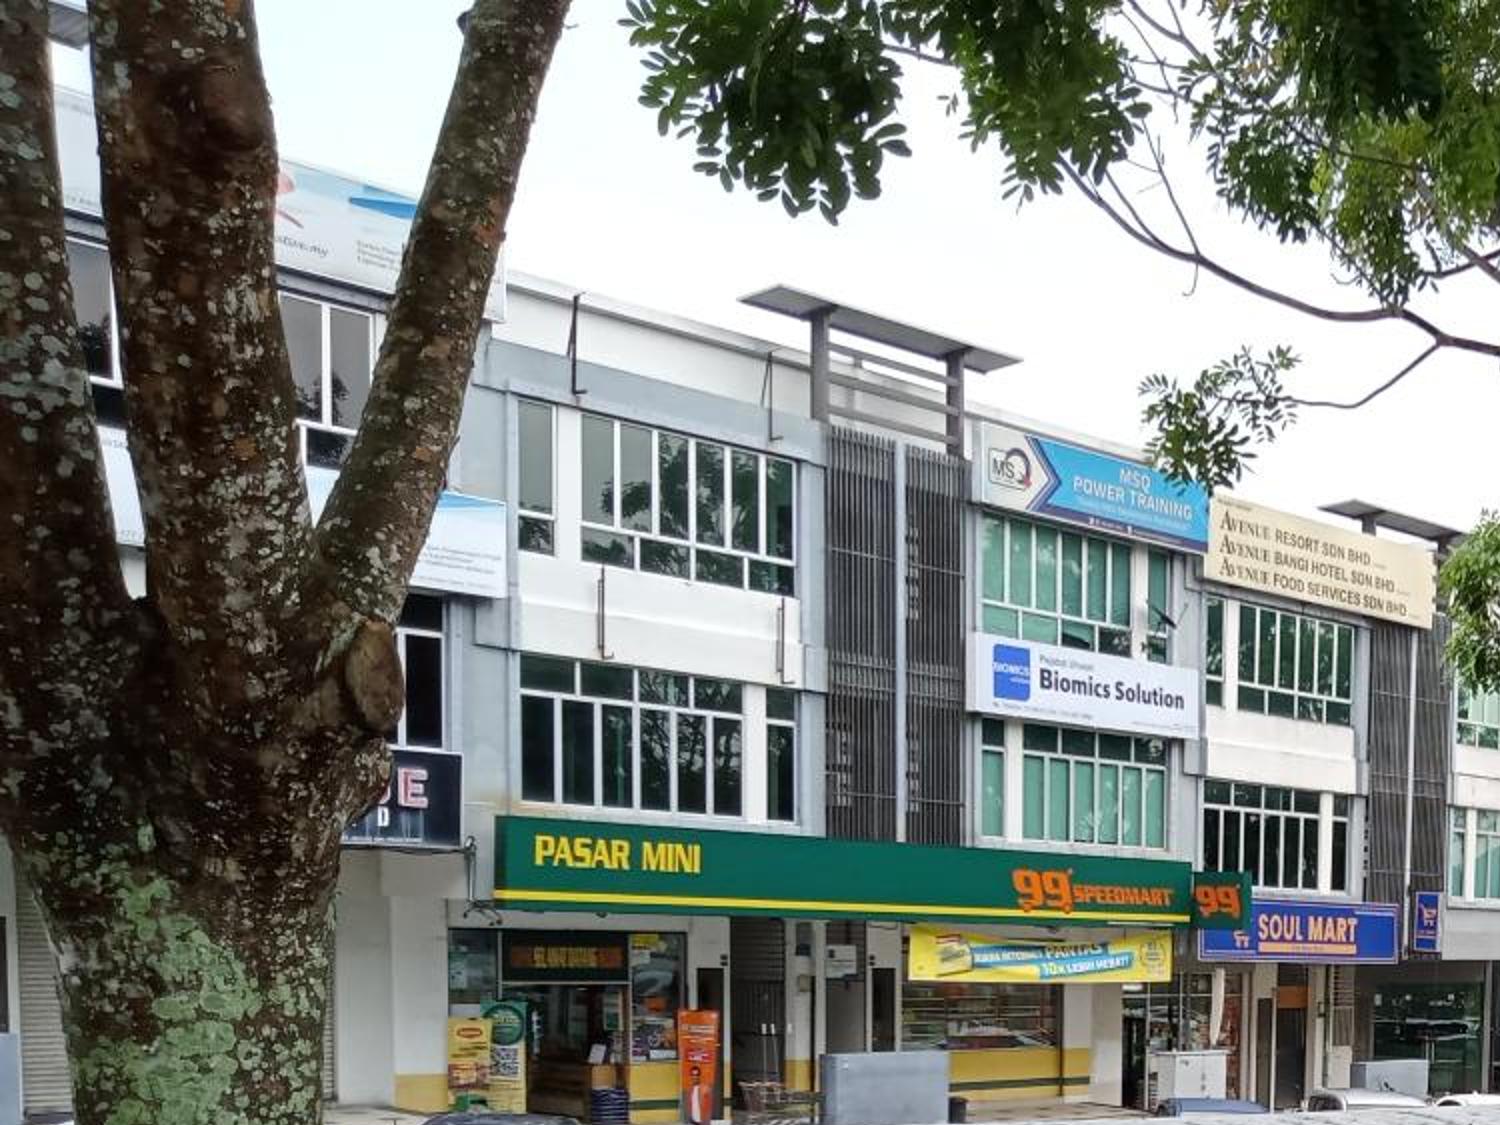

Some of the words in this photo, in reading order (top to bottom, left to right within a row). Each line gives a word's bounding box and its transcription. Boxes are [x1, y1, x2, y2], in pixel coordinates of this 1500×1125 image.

[1073, 476, 1125, 504] POWER
[1130, 490, 1193, 520] TRAINING
[1120, 468, 1151, 493] MSQ
[1275, 527, 1319, 553] RESORT
[1321, 541, 1345, 559] SDN
[1347, 547, 1370, 566] BHD
[1274, 551, 1309, 571] BANGI
[1311, 562, 1347, 583] HOTEL
[1351, 571, 1372, 588] SDN
[1375, 577, 1395, 593] BHD
[1273, 573, 1304, 592] FOOD
[1307, 582, 1360, 606] SERVICES
[1363, 594, 1383, 612] SDN
[1386, 600, 1407, 617] BHD
[1040, 667, 1110, 699] Biomics
[1115, 681, 1184, 709] Solution
[534, 835, 630, 871] PASAR
[642, 841, 701, 874] MINI
[1012, 868, 1073, 912] 99
[1072, 884, 1174, 906] SPEEDMART
[1194, 884, 1241, 918] 99
[1258, 914, 1303, 941] SOUL
[1308, 916, 1358, 943] MART
